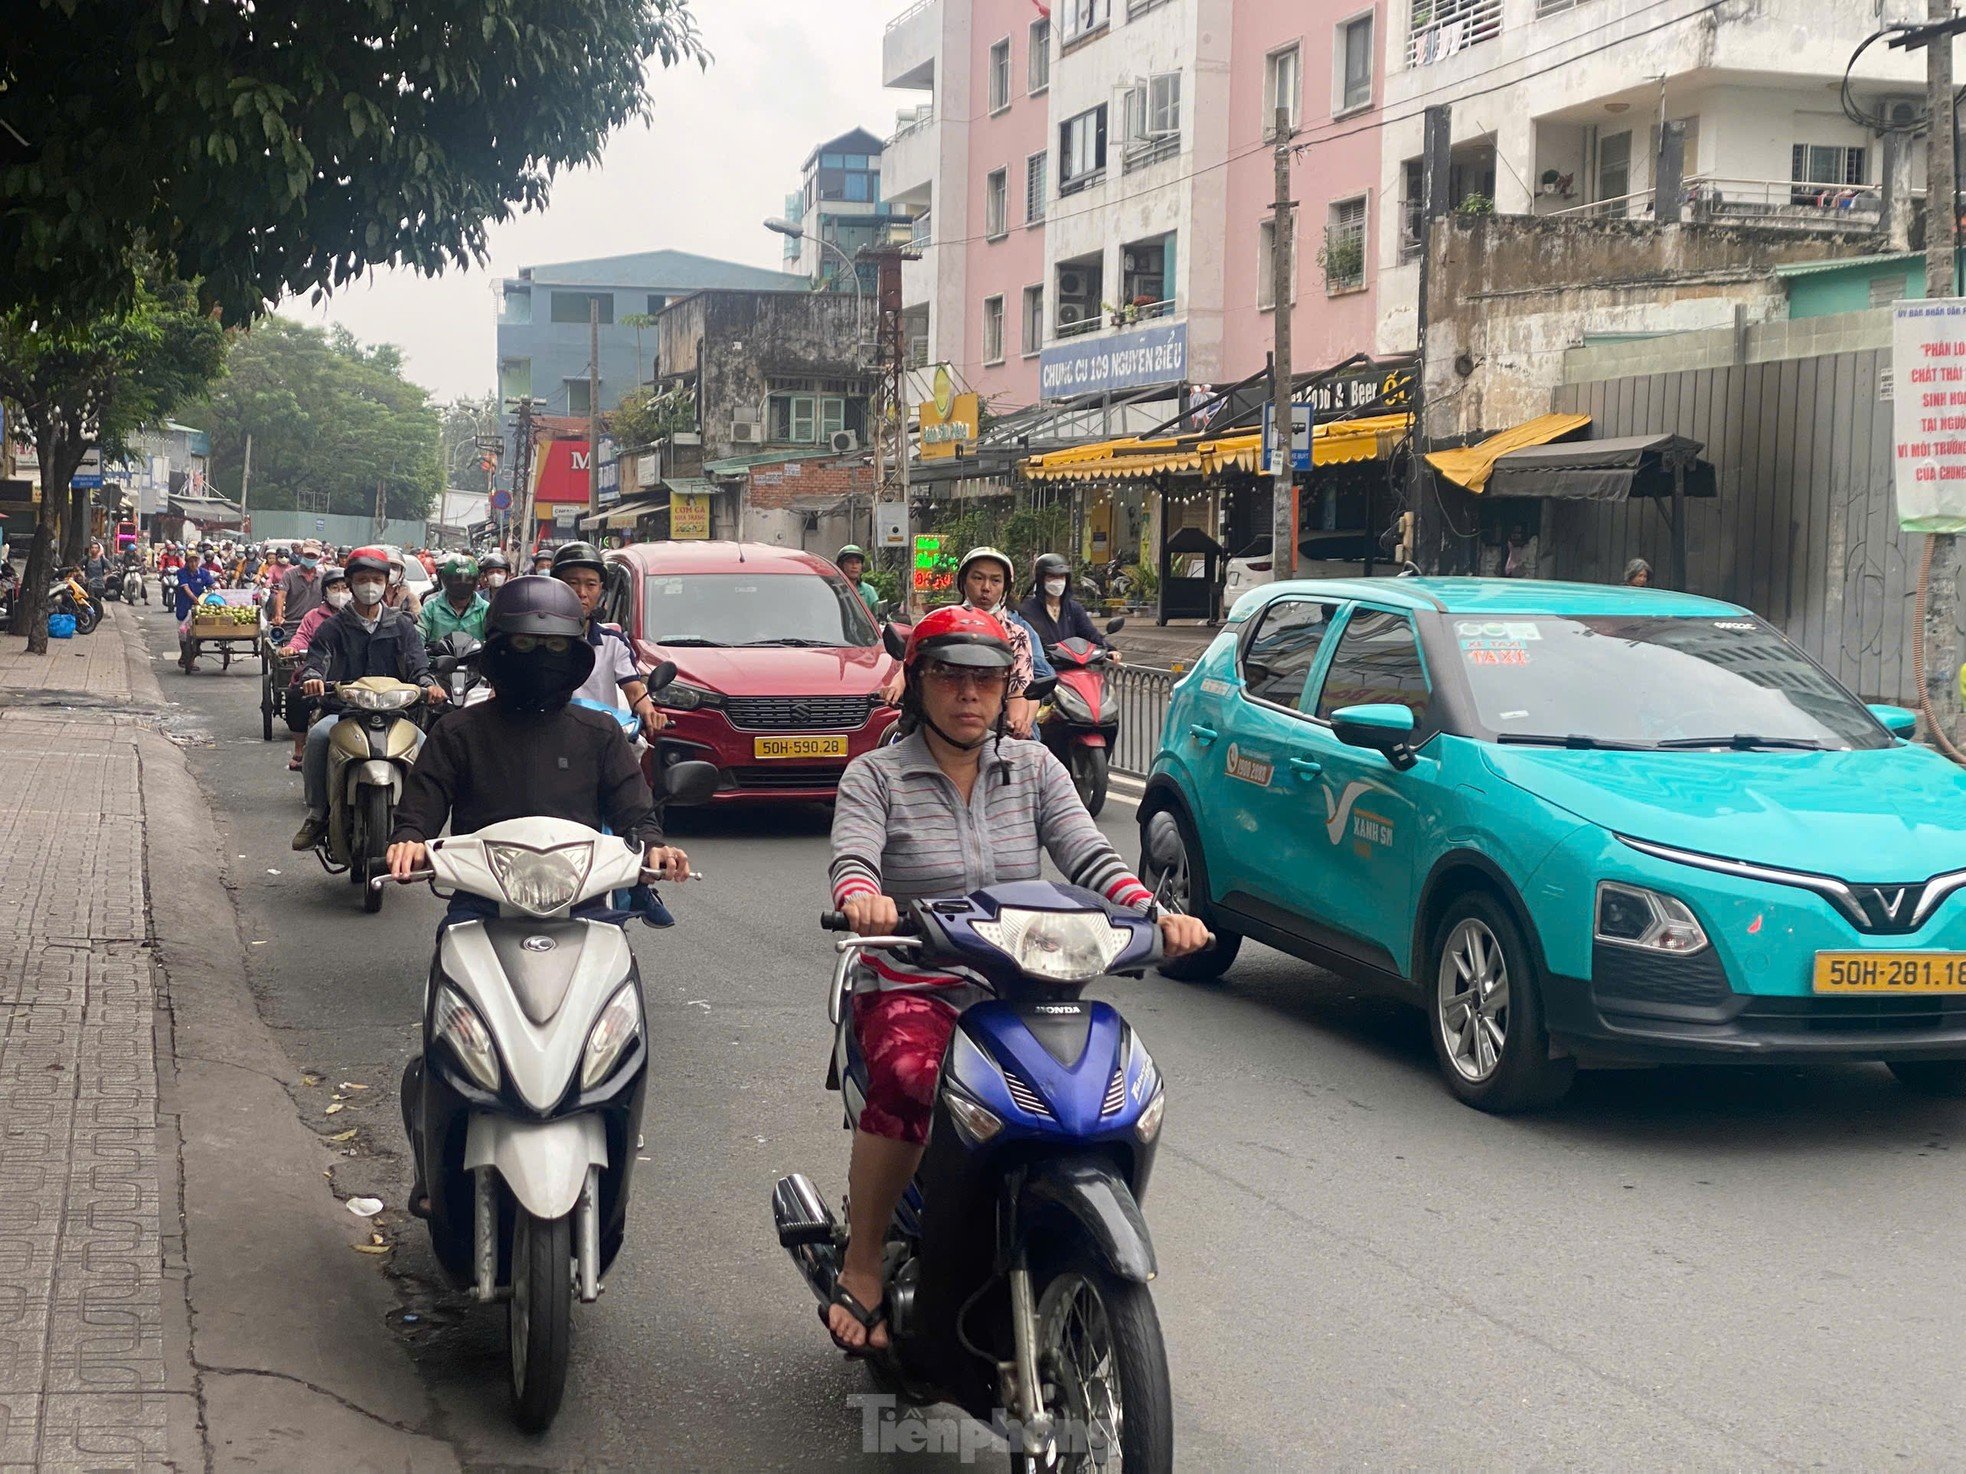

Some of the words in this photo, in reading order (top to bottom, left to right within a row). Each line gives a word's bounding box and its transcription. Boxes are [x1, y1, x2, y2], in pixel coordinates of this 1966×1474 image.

[1335, 382, 1345, 408] &
[1351, 380, 1377, 406] Beer
[1923, 391, 1946, 407] SINH
[1468, 648, 1528, 667] TAXI
[763, 741, 839, 754] 50H-590.28
[1353, 815, 1379, 843] XANH
[1380, 824, 1393, 847] SM
[1035, 1006, 1081, 1014] HONDA
